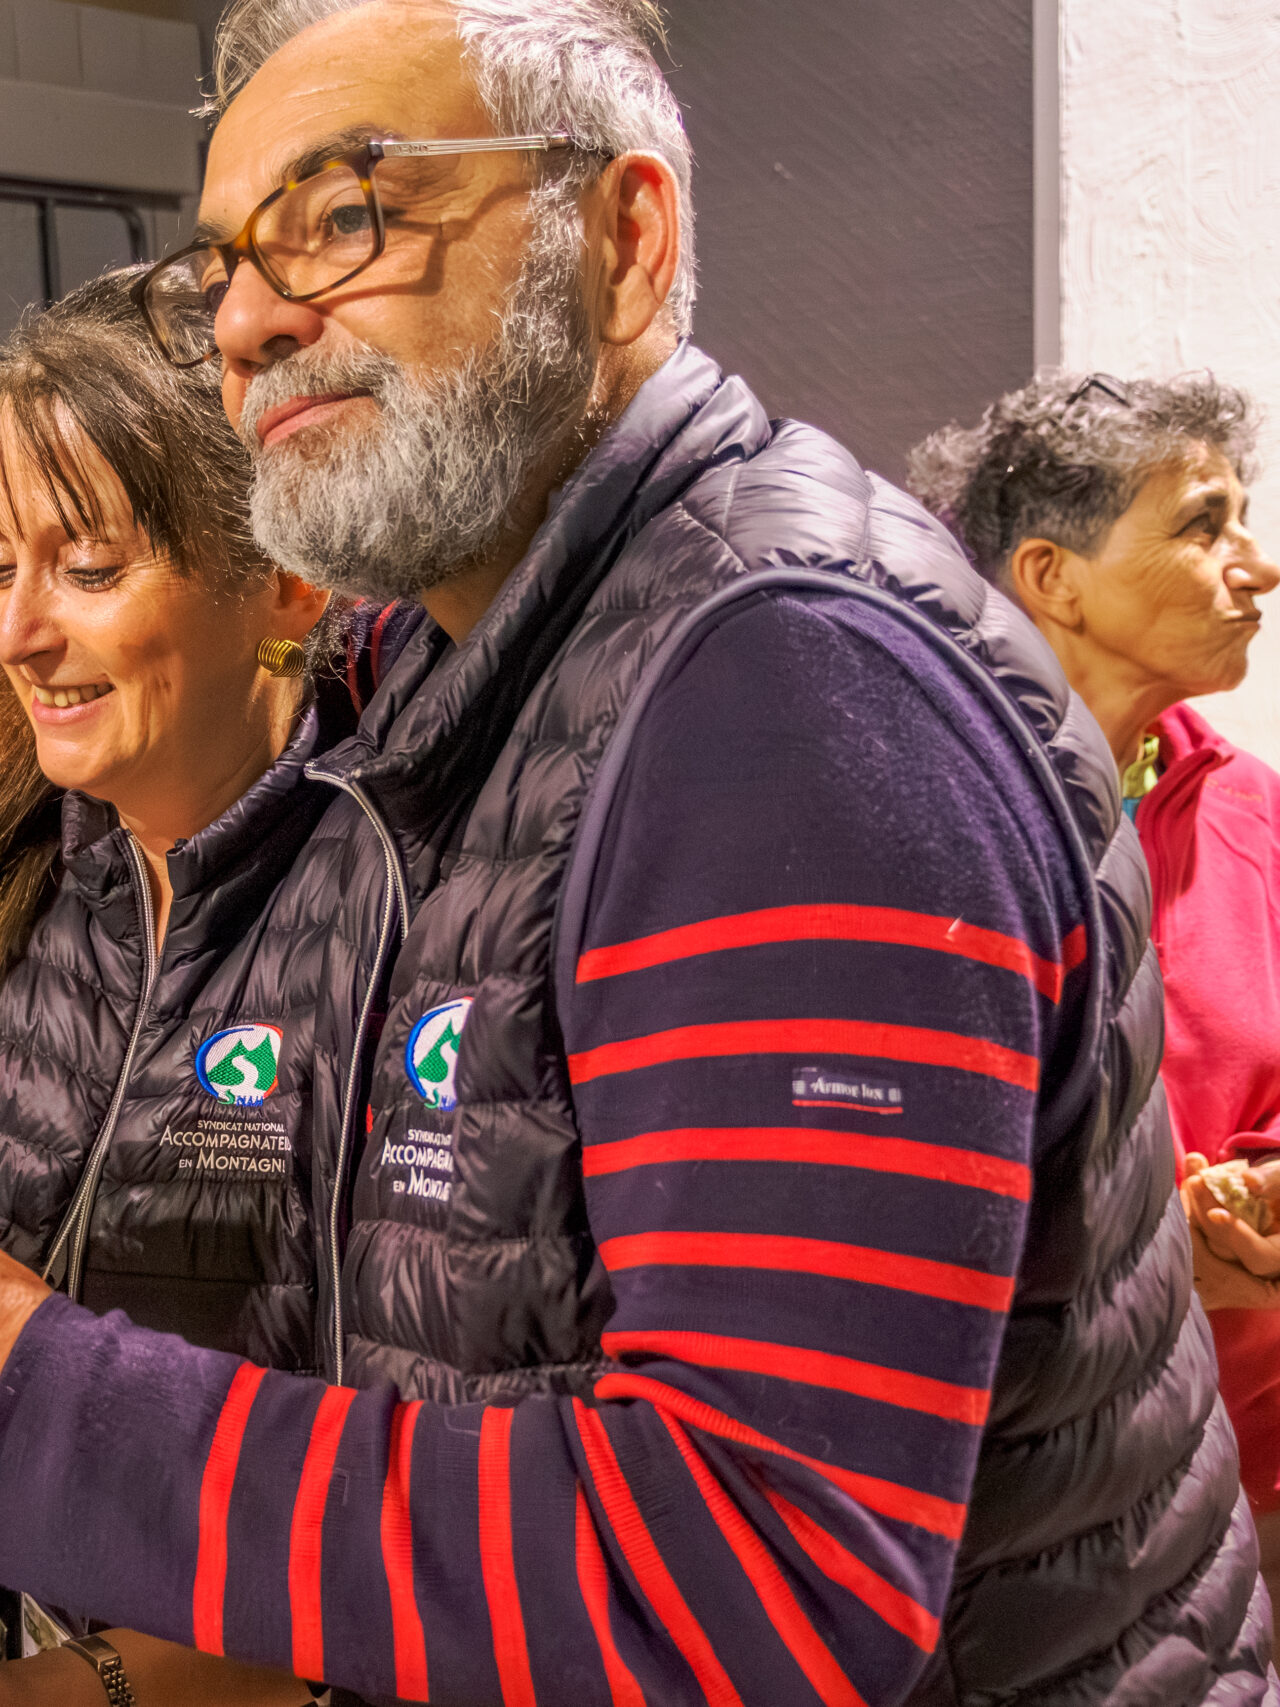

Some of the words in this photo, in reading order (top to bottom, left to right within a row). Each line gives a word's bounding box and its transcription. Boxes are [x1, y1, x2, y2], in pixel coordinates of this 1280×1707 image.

[197, 1120, 242, 1131] SYNDICAT
[244, 1122, 284, 1133] NATIONAL
[179, 1159, 192, 1168] EN
[393, 1180, 406, 1193] EN
